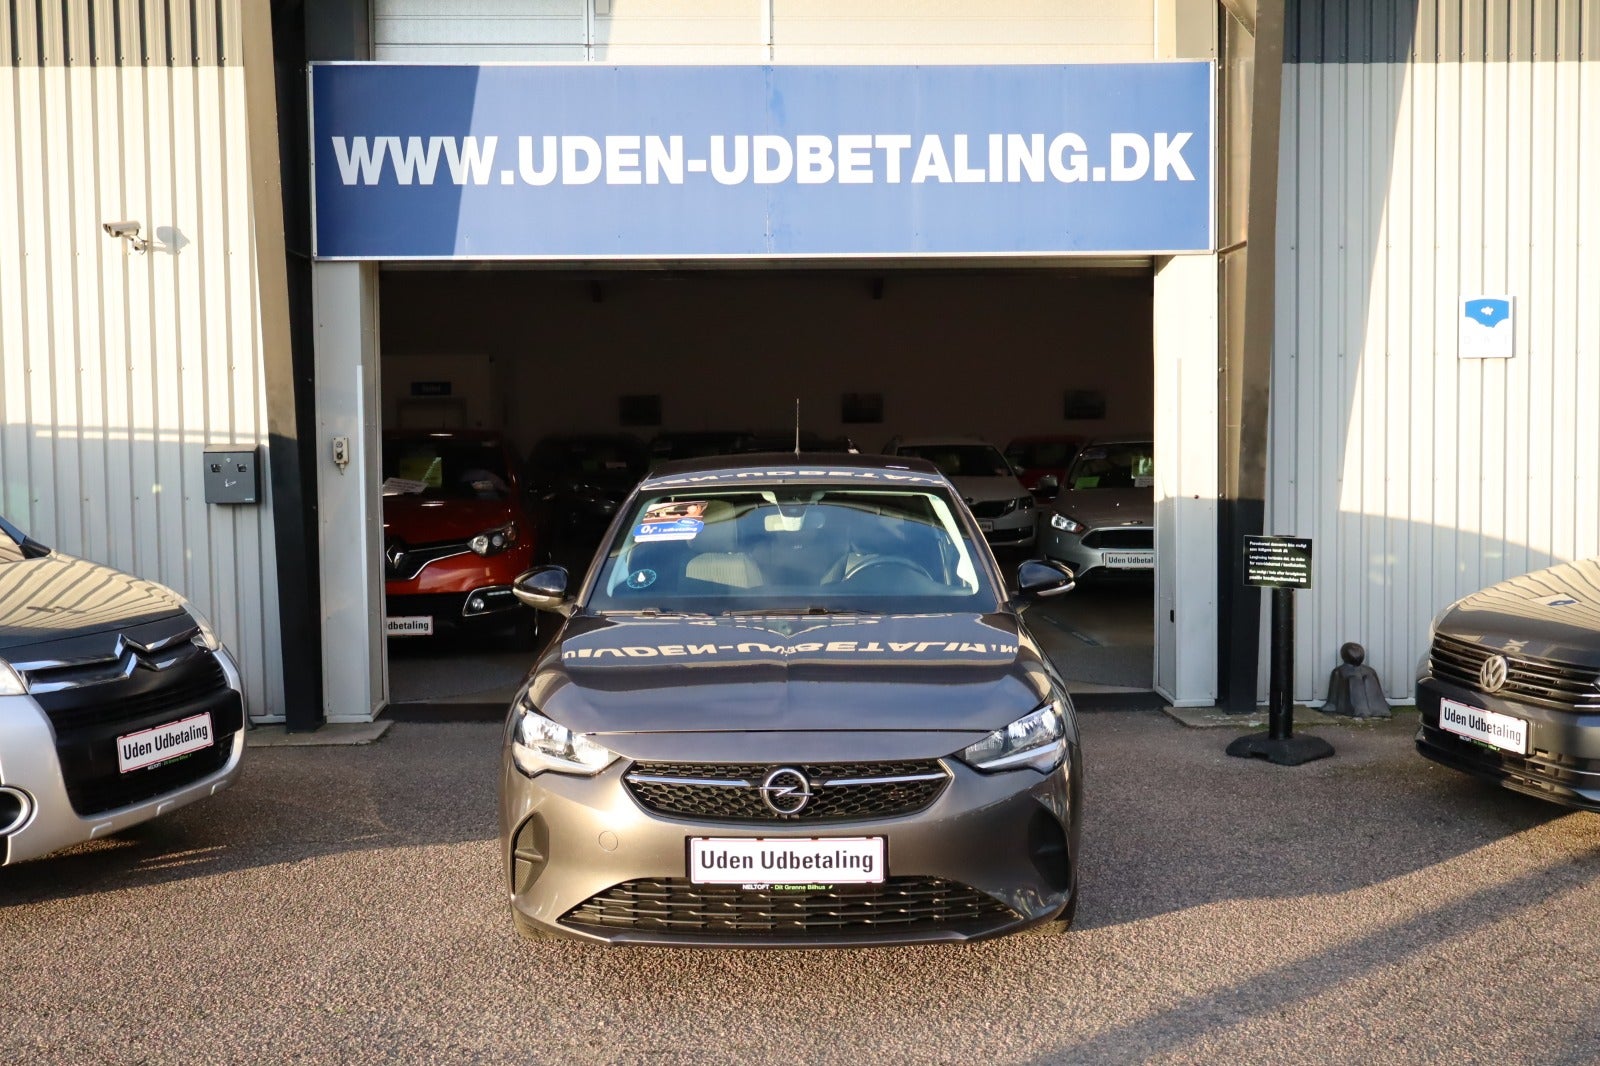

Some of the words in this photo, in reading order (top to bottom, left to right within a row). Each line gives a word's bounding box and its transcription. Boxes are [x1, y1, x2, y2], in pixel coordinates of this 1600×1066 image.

[331, 132, 1196, 186] WWW.UDEN-UDBETALING.DK
[1108, 556, 1126, 564] Uden
[387, 620, 429, 631] dbetaling
[1444, 706, 1467, 726] Uden
[1468, 714, 1521, 746] Udbetaling
[123, 741, 152, 760] Uden
[154, 725, 208, 751] Udbetaling
[701, 850, 753, 869] Uden
[761, 850, 874, 873] Udbetaling
